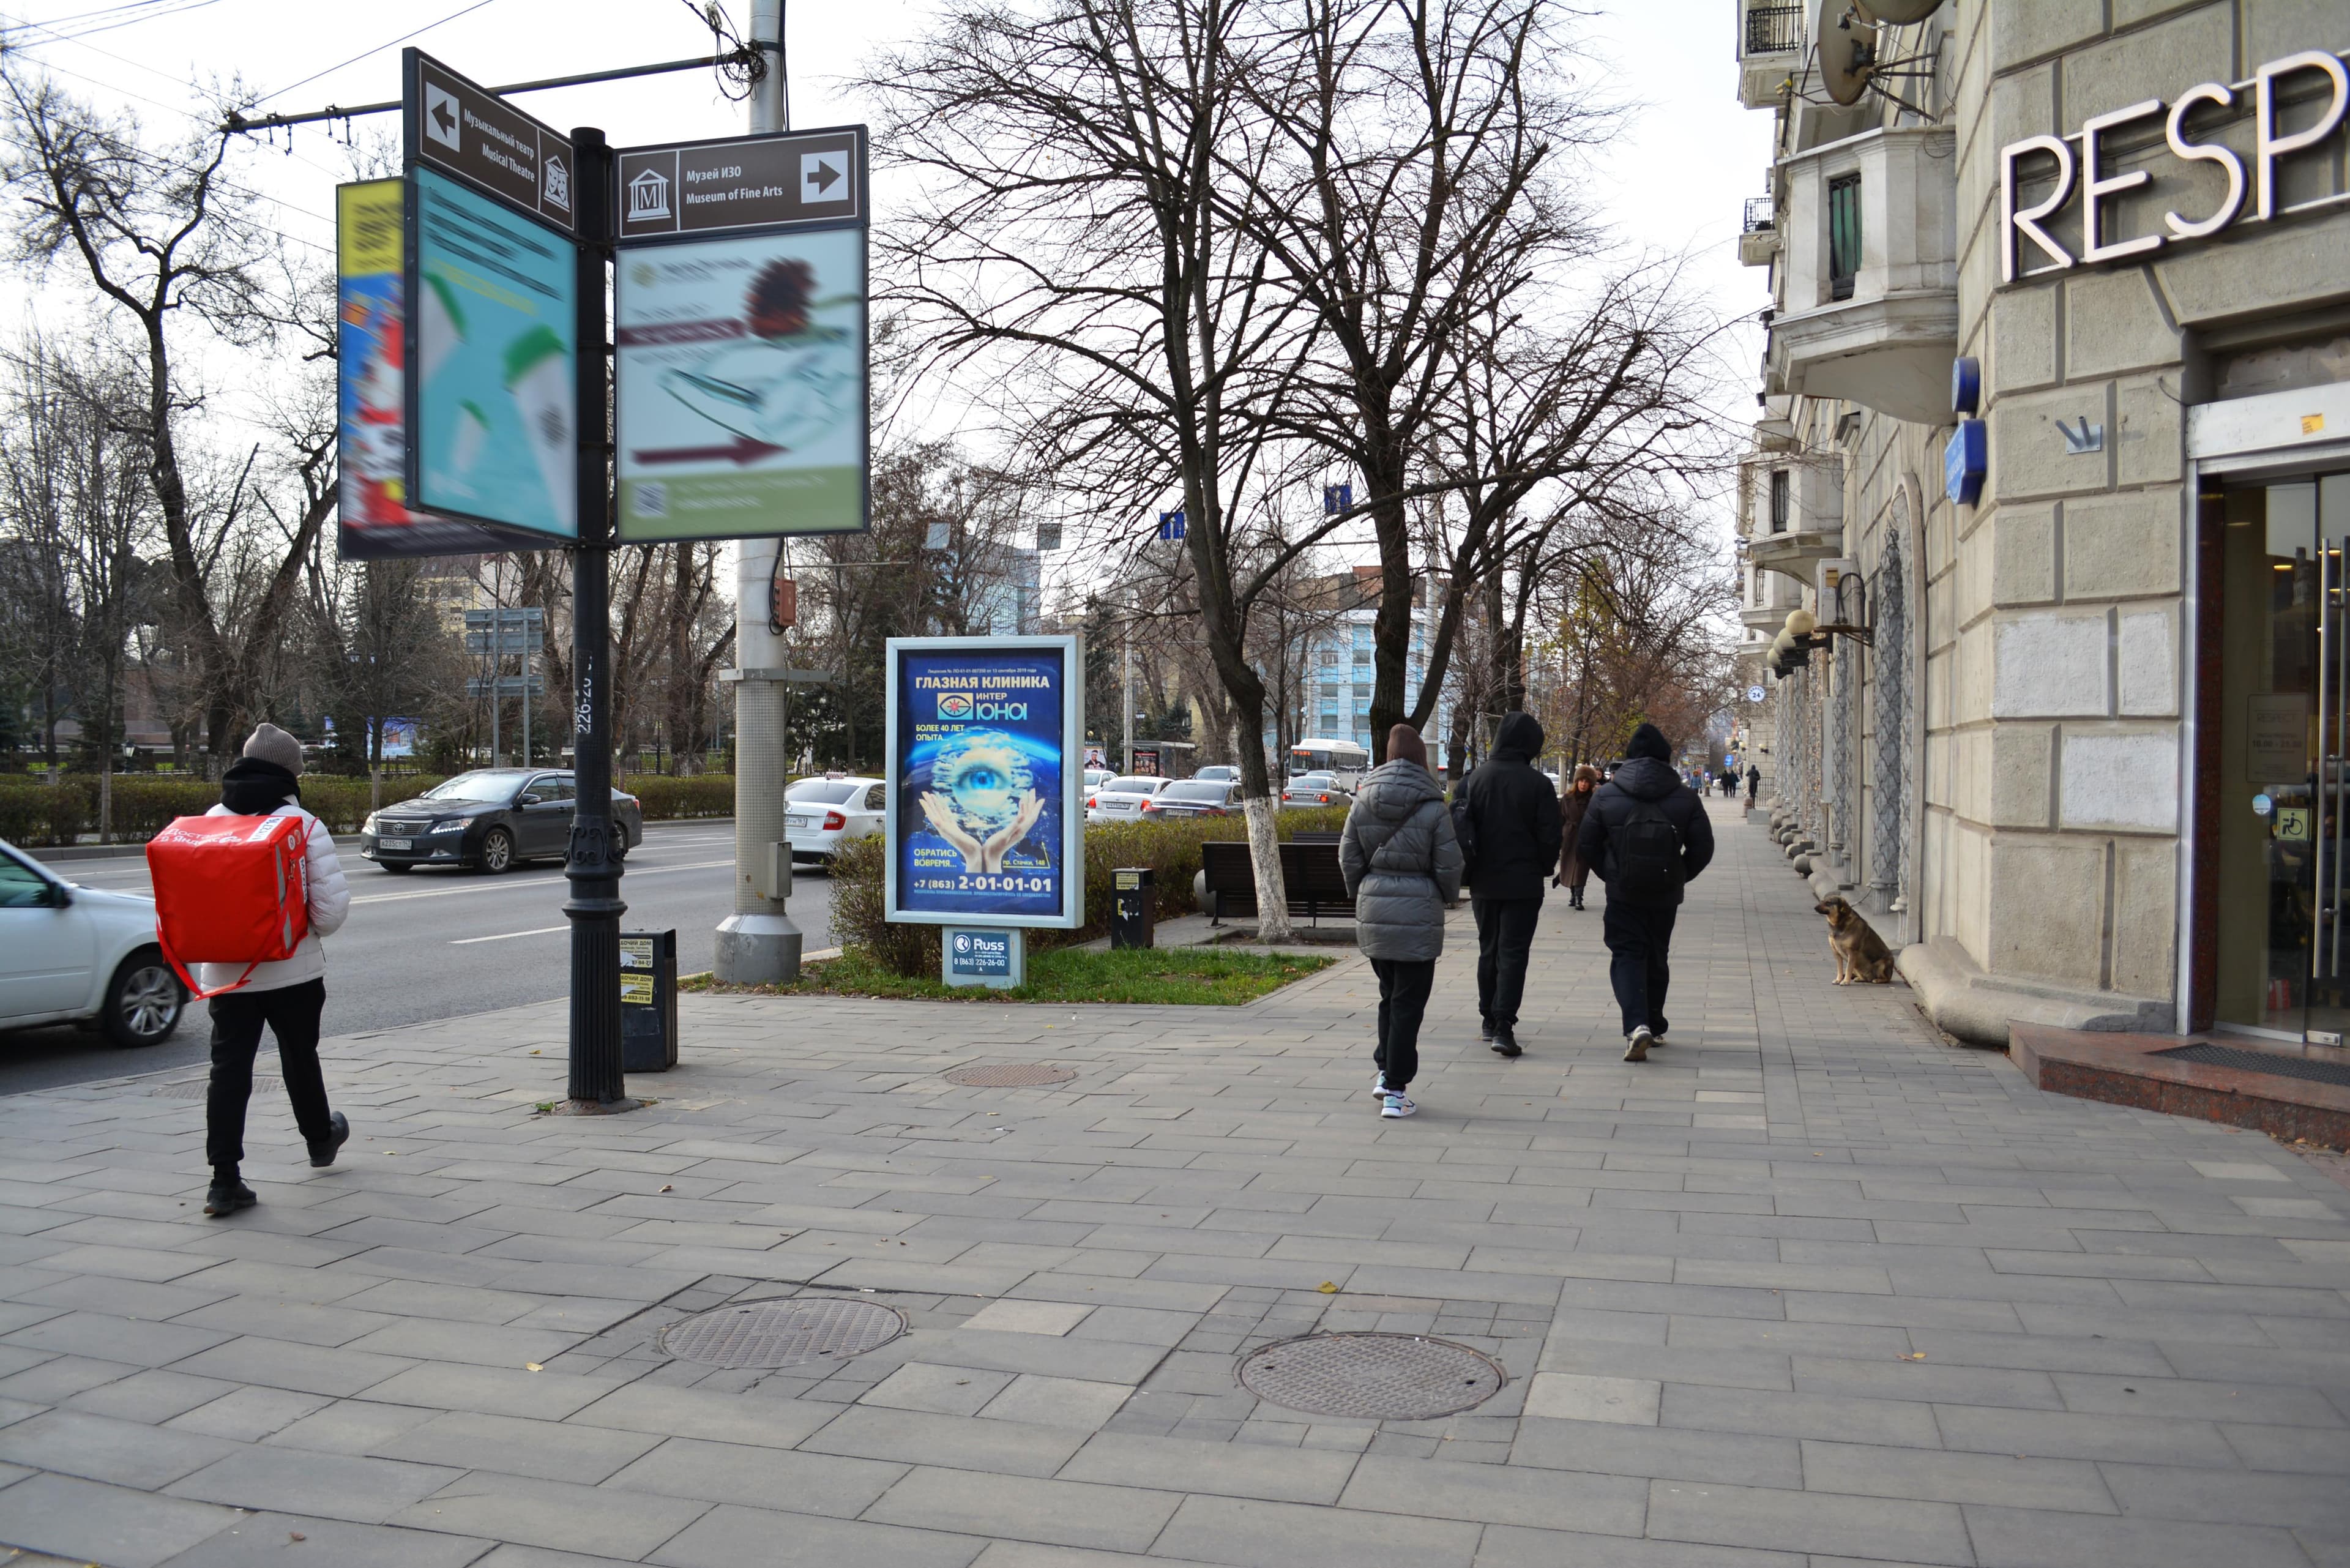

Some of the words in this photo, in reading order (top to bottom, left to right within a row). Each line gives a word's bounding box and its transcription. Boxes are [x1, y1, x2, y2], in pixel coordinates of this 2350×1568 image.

[464, 108, 515, 147] Музыкальный
[516, 140, 534, 160] театр
[482, 143, 508, 168] Musical
[509, 157, 535, 182] Theatre
[687, 168, 718, 184] Музей
[722, 166, 741, 178] ИЗО
[687, 192, 726, 204] Museum
[728, 189, 739, 200] of
[740, 188, 761, 199] Fine
[763, 186, 783, 197] Arts
[916, 677, 979, 689] ГЛАЗНАЯ
[982, 676, 1050, 688] КЛИНИКА
[928, 879, 955, 890] (863)
[959, 876, 1051, 892] 2-01-01-01
[974, 938, 1005, 950] Russ
[959, 957, 974, 966] (863)
